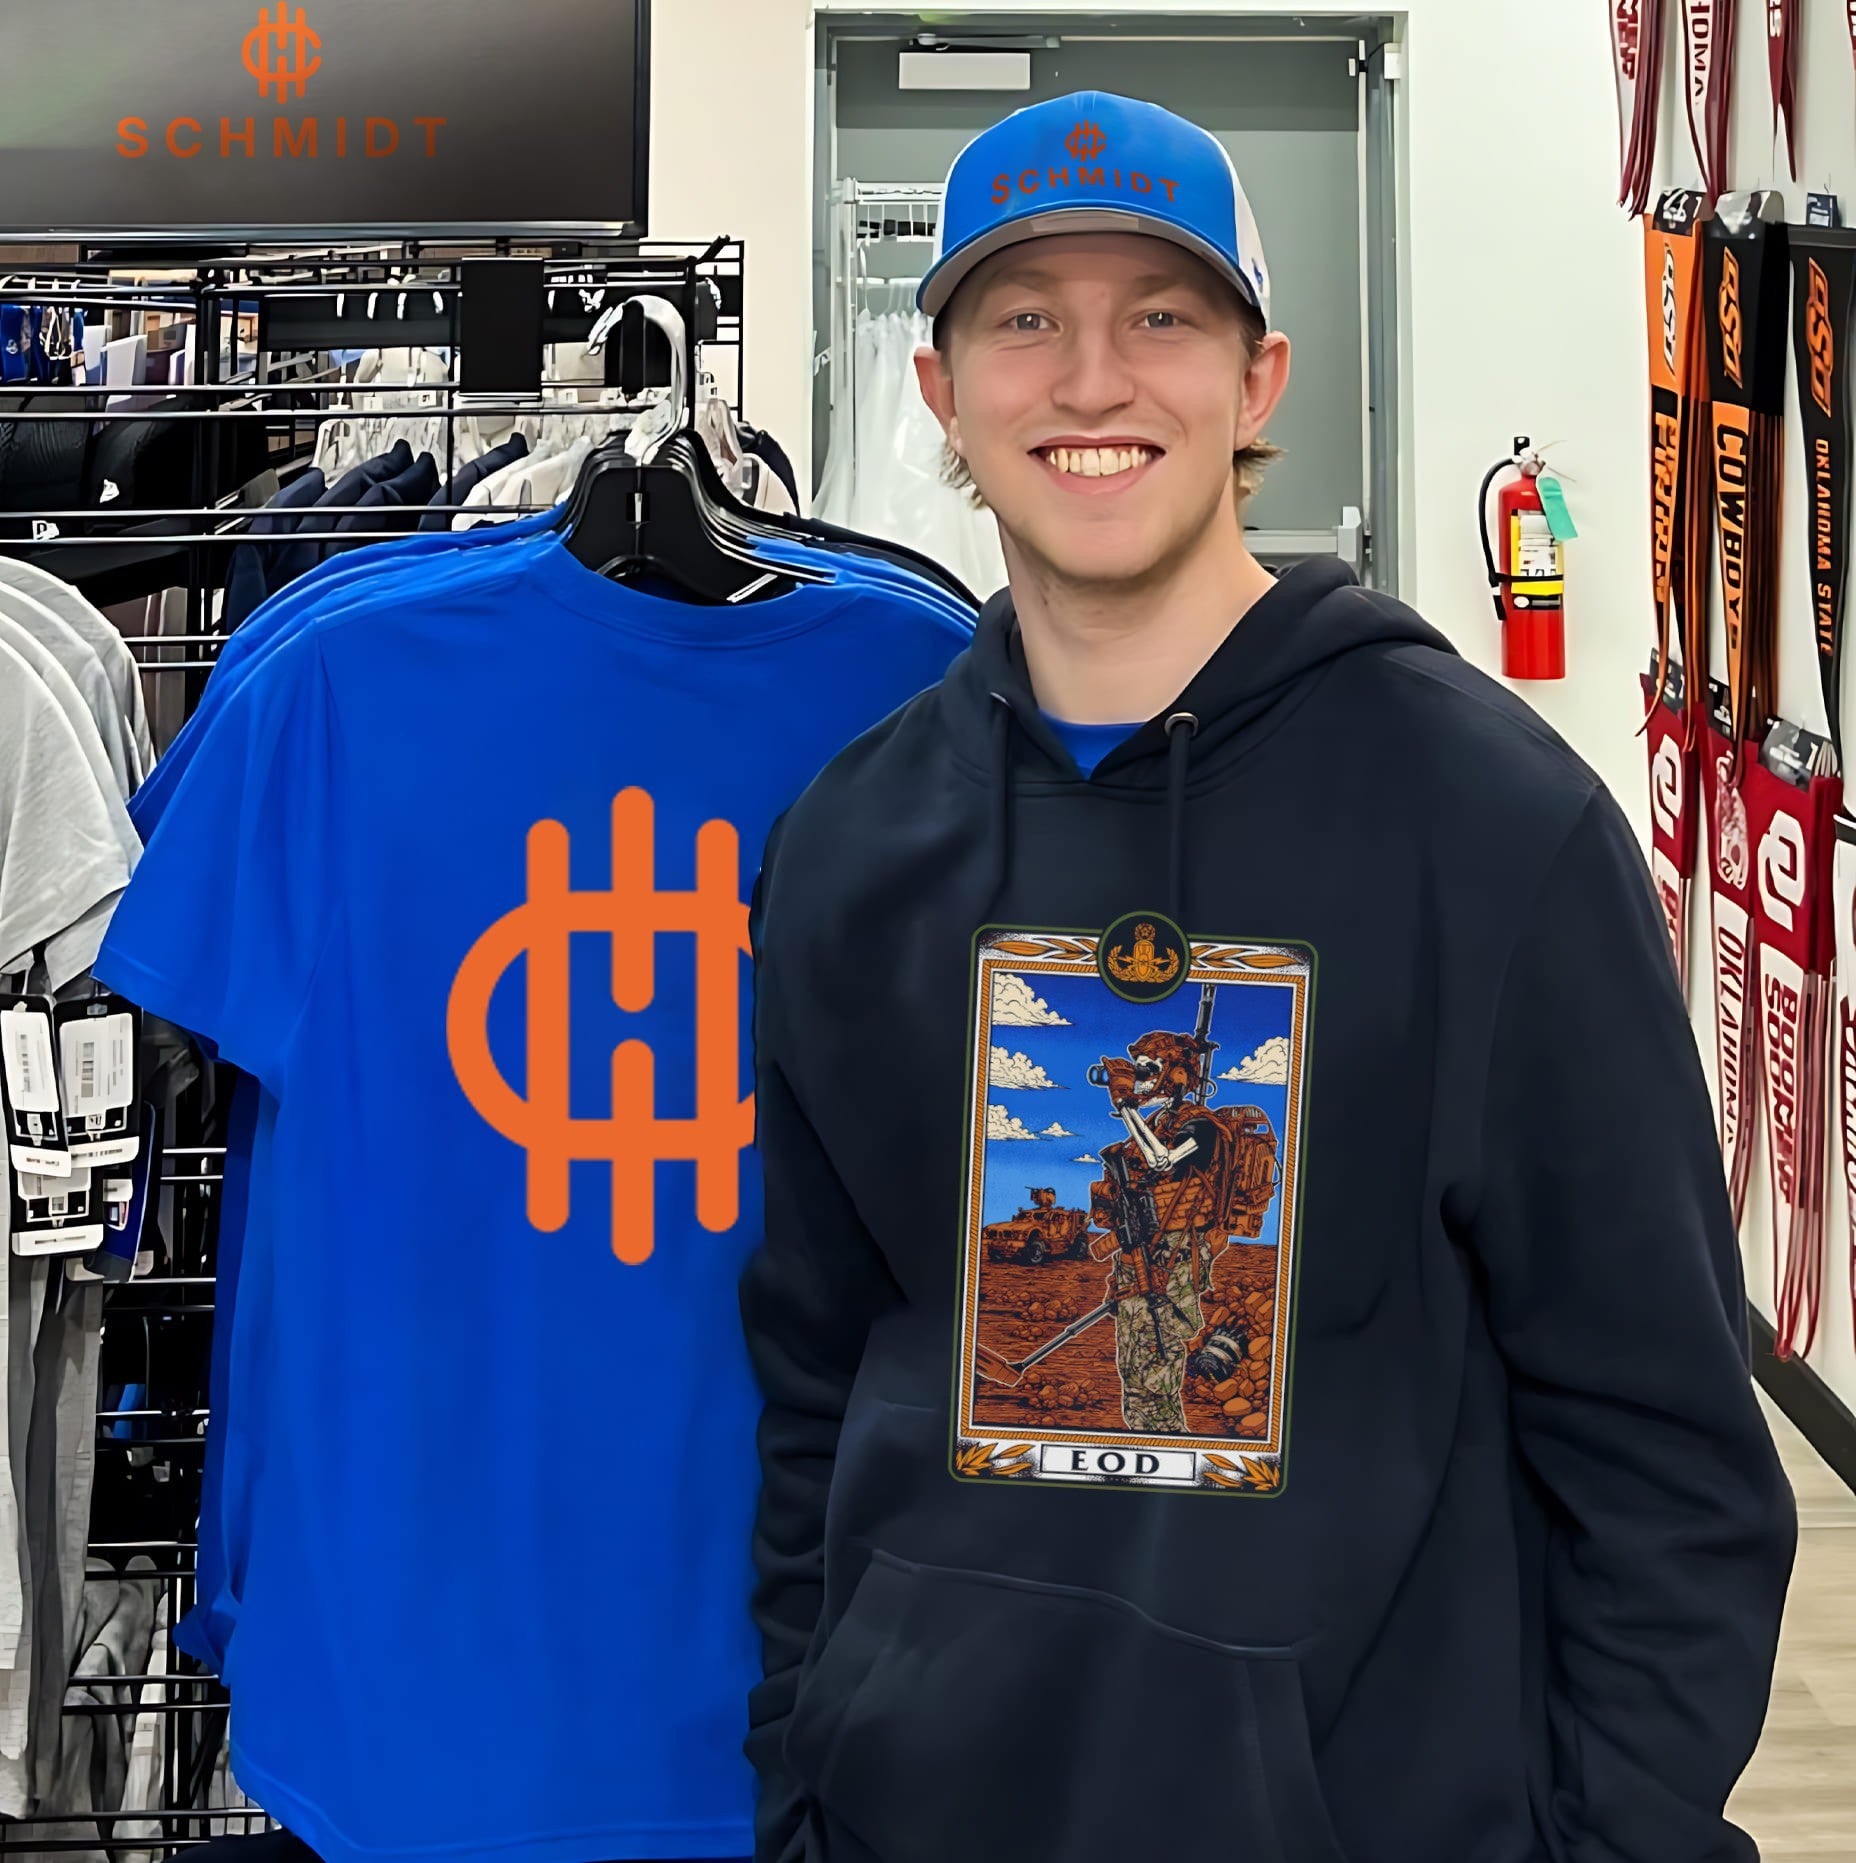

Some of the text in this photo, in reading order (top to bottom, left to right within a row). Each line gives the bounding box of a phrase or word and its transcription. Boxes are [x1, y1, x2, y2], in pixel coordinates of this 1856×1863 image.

[116, 116, 448, 159] SCHMIDT
[991, 167, 1179, 204] SCHMIDT
[1815, 438, 1832, 571] OKLAHOMA
[1071, 1449, 1160, 1475] EOD
